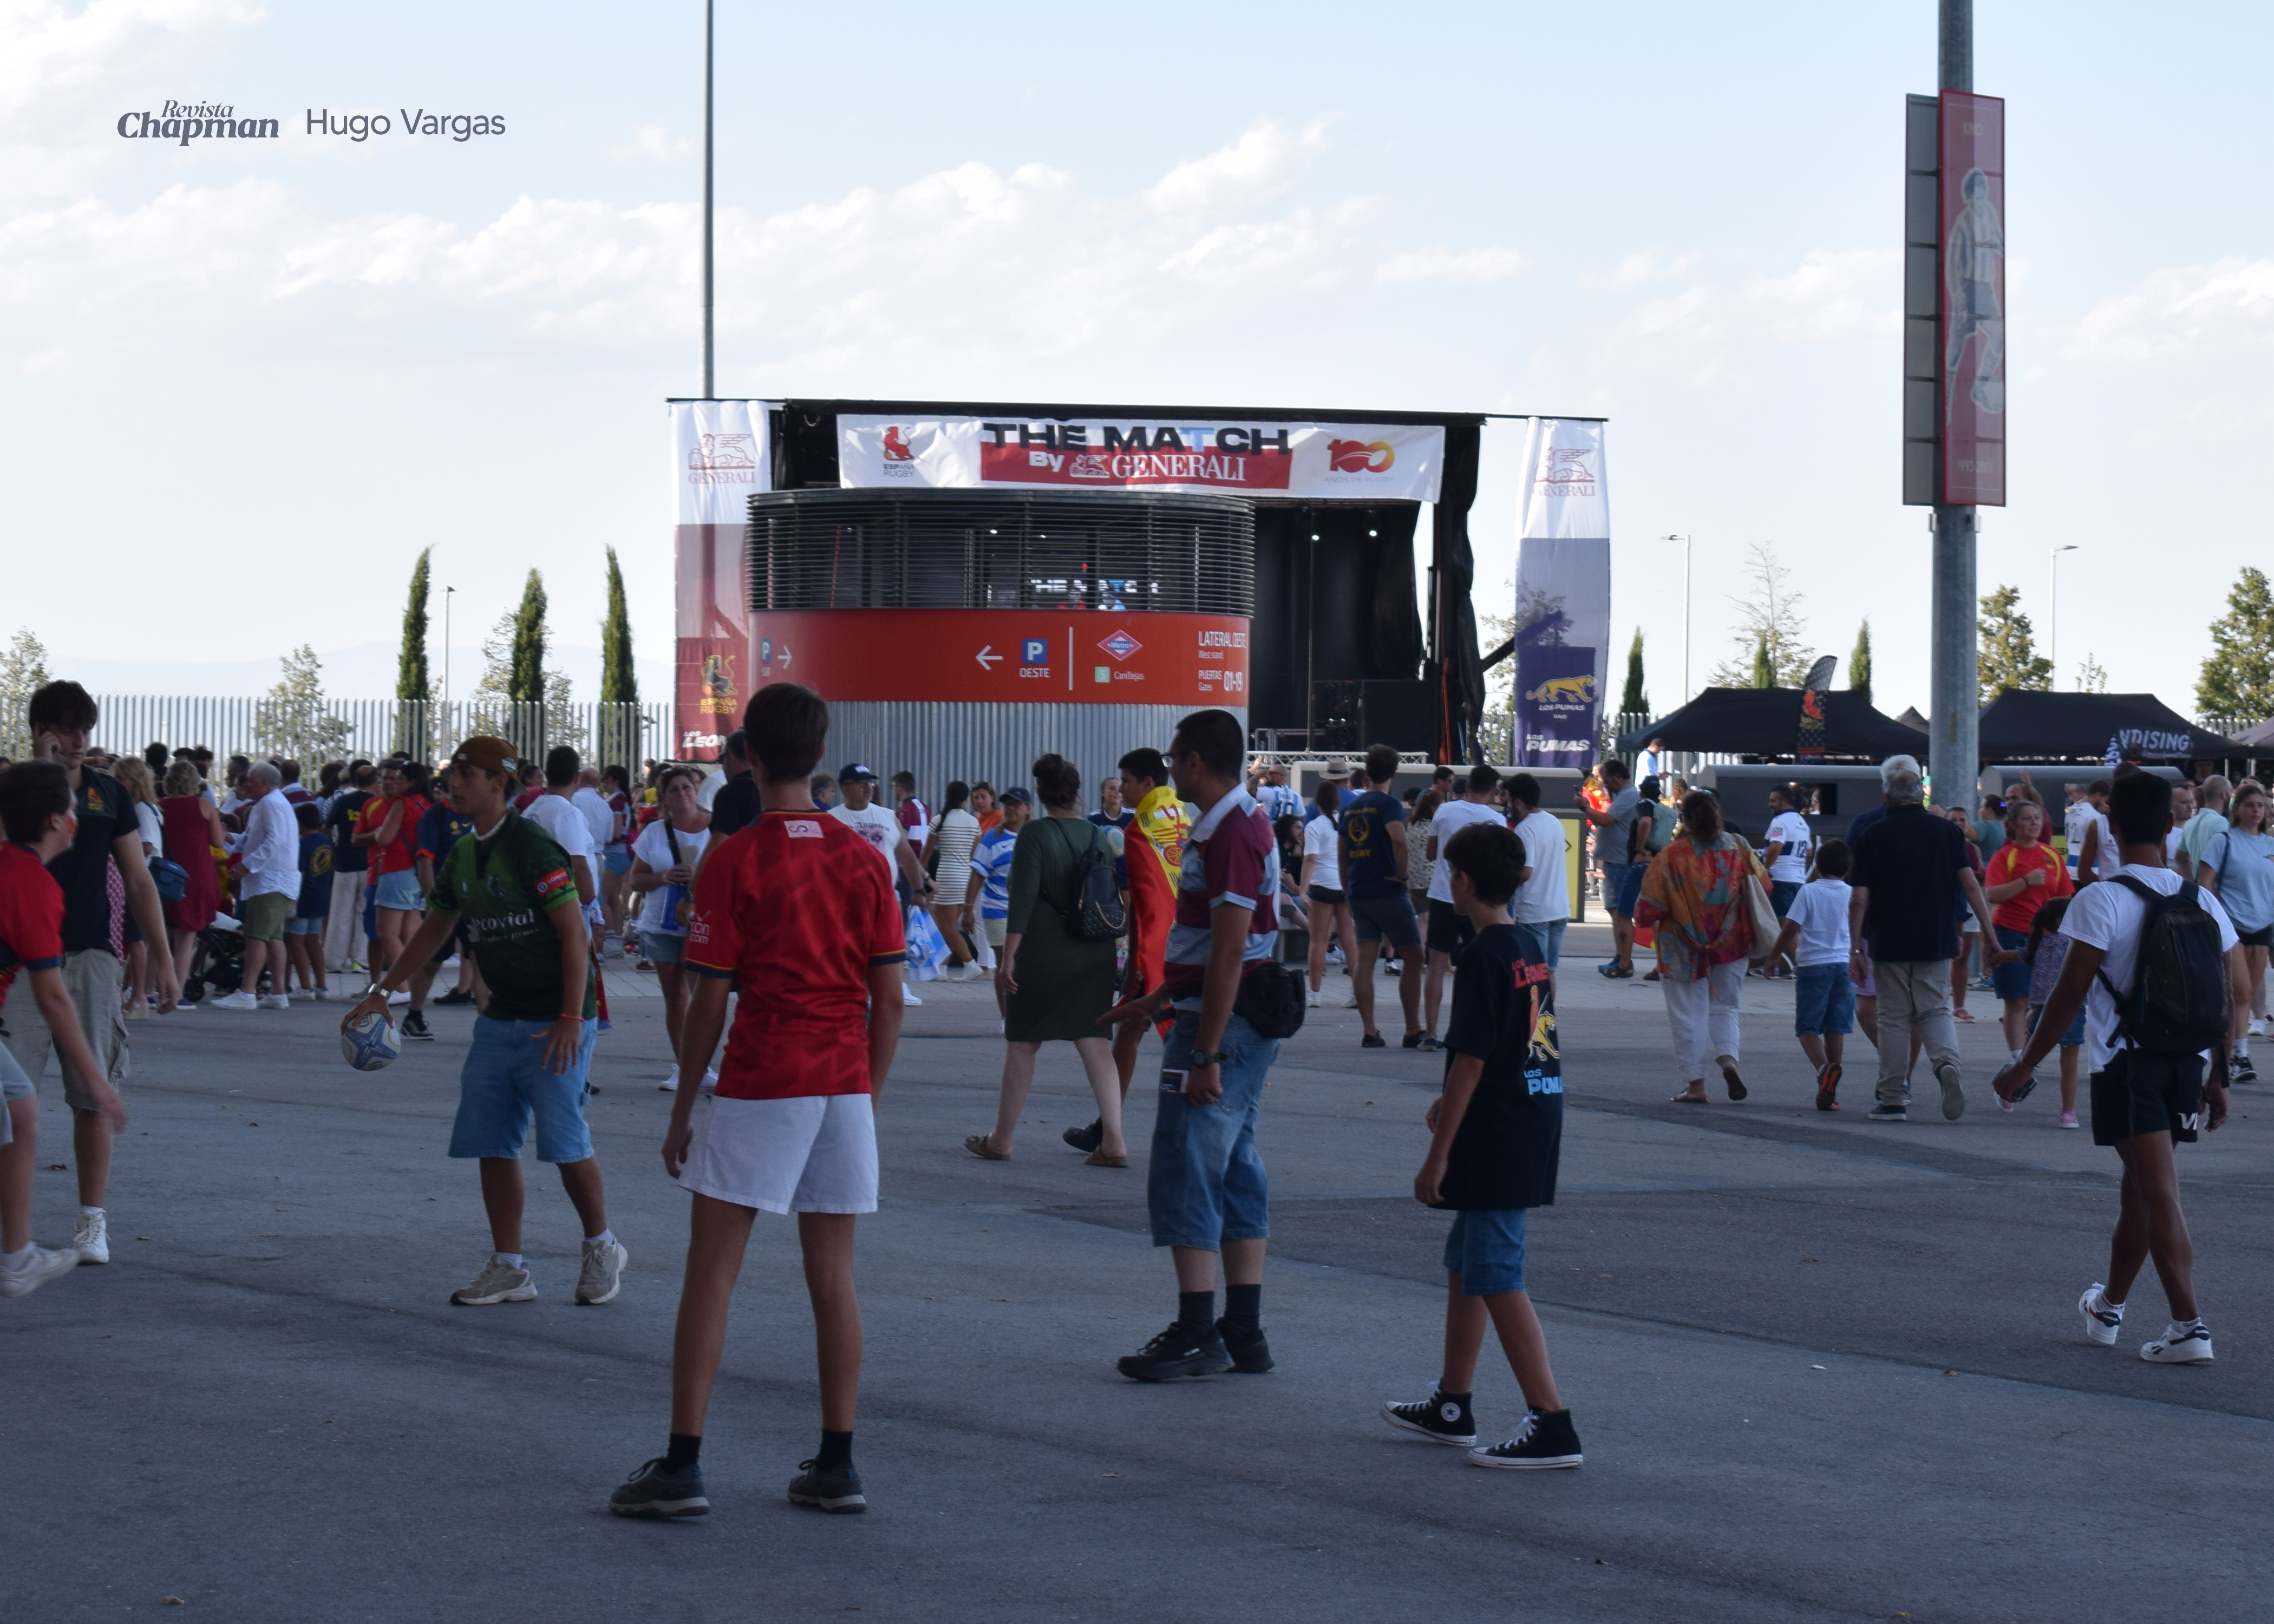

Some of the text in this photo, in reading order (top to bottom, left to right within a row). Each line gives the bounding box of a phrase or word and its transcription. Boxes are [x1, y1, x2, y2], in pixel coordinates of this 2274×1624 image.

[981, 422, 1289, 456] THE MATCH
[883, 462, 914, 471] ESPAÑA
[1030, 451, 1247, 481] By GENERALI
[688, 472, 756, 484] GENERALI
[883, 471, 914, 480] RUGBY
[1533, 485, 1596, 496] GENERALI
[1198, 631, 1232, 647] LATERAL
[1110, 640, 1131, 650] Metro
[1027, 642, 1044, 661] P
[1019, 667, 1051, 678] OESTE
[1114, 671, 1145, 682] Canillejas
[1198, 670, 1223, 680] PUERTAS
[701, 697, 739, 705] ESPAÑA
[700, 705, 737, 714] RUGBY
[1526, 739, 1591, 752] PUMAS
[1524, 1068, 1543, 1078] LOS
